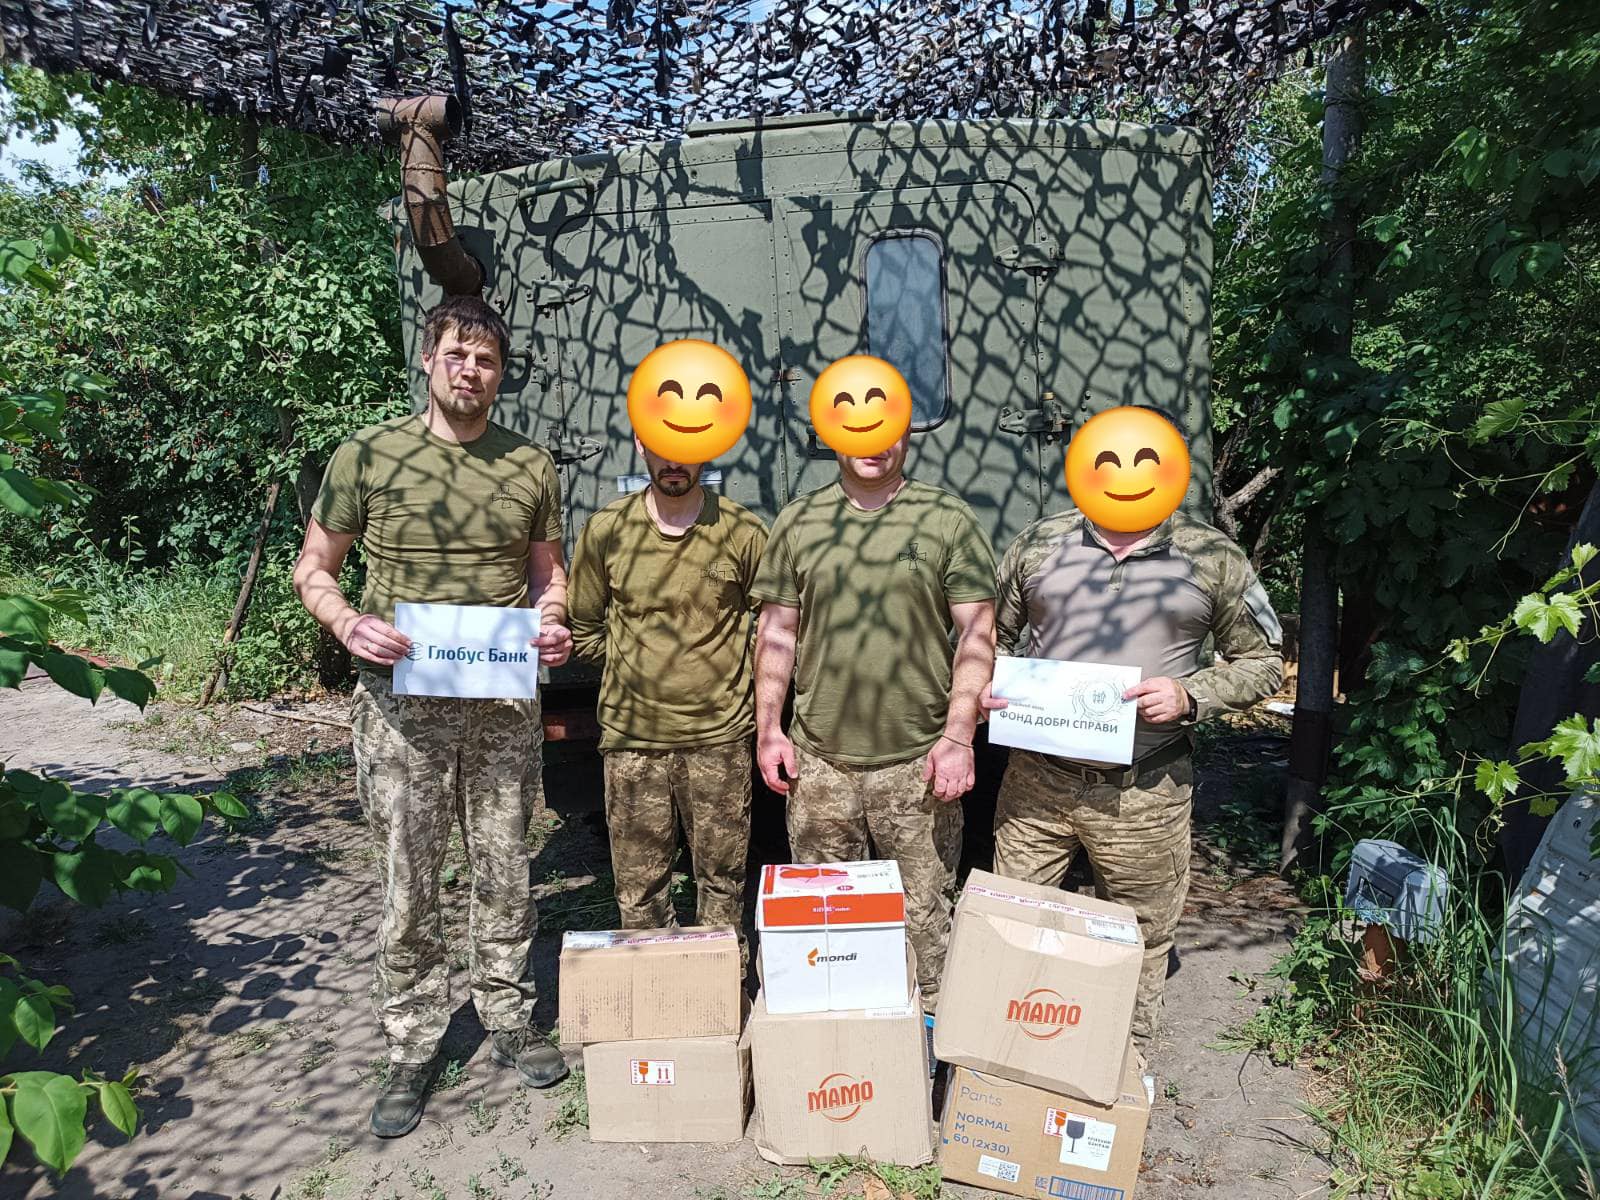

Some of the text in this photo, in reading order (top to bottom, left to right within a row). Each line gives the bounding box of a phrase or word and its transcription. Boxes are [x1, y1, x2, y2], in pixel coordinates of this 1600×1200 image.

[428, 645, 528, 664] Глобус Банк
[1000, 710, 1118, 734] ФОНД ДОБРІ СПРАВИ
[816, 952, 858, 963] mondi
[1007, 999, 1082, 1025] MAMO
[807, 1080, 874, 1112] MAMO
[960, 1086, 1003, 1107] Pants
[954, 1122, 965, 1132] M
[956, 1111, 1011, 1133] NORMAL
[953, 1134, 1010, 1156] 60 (2x30)
